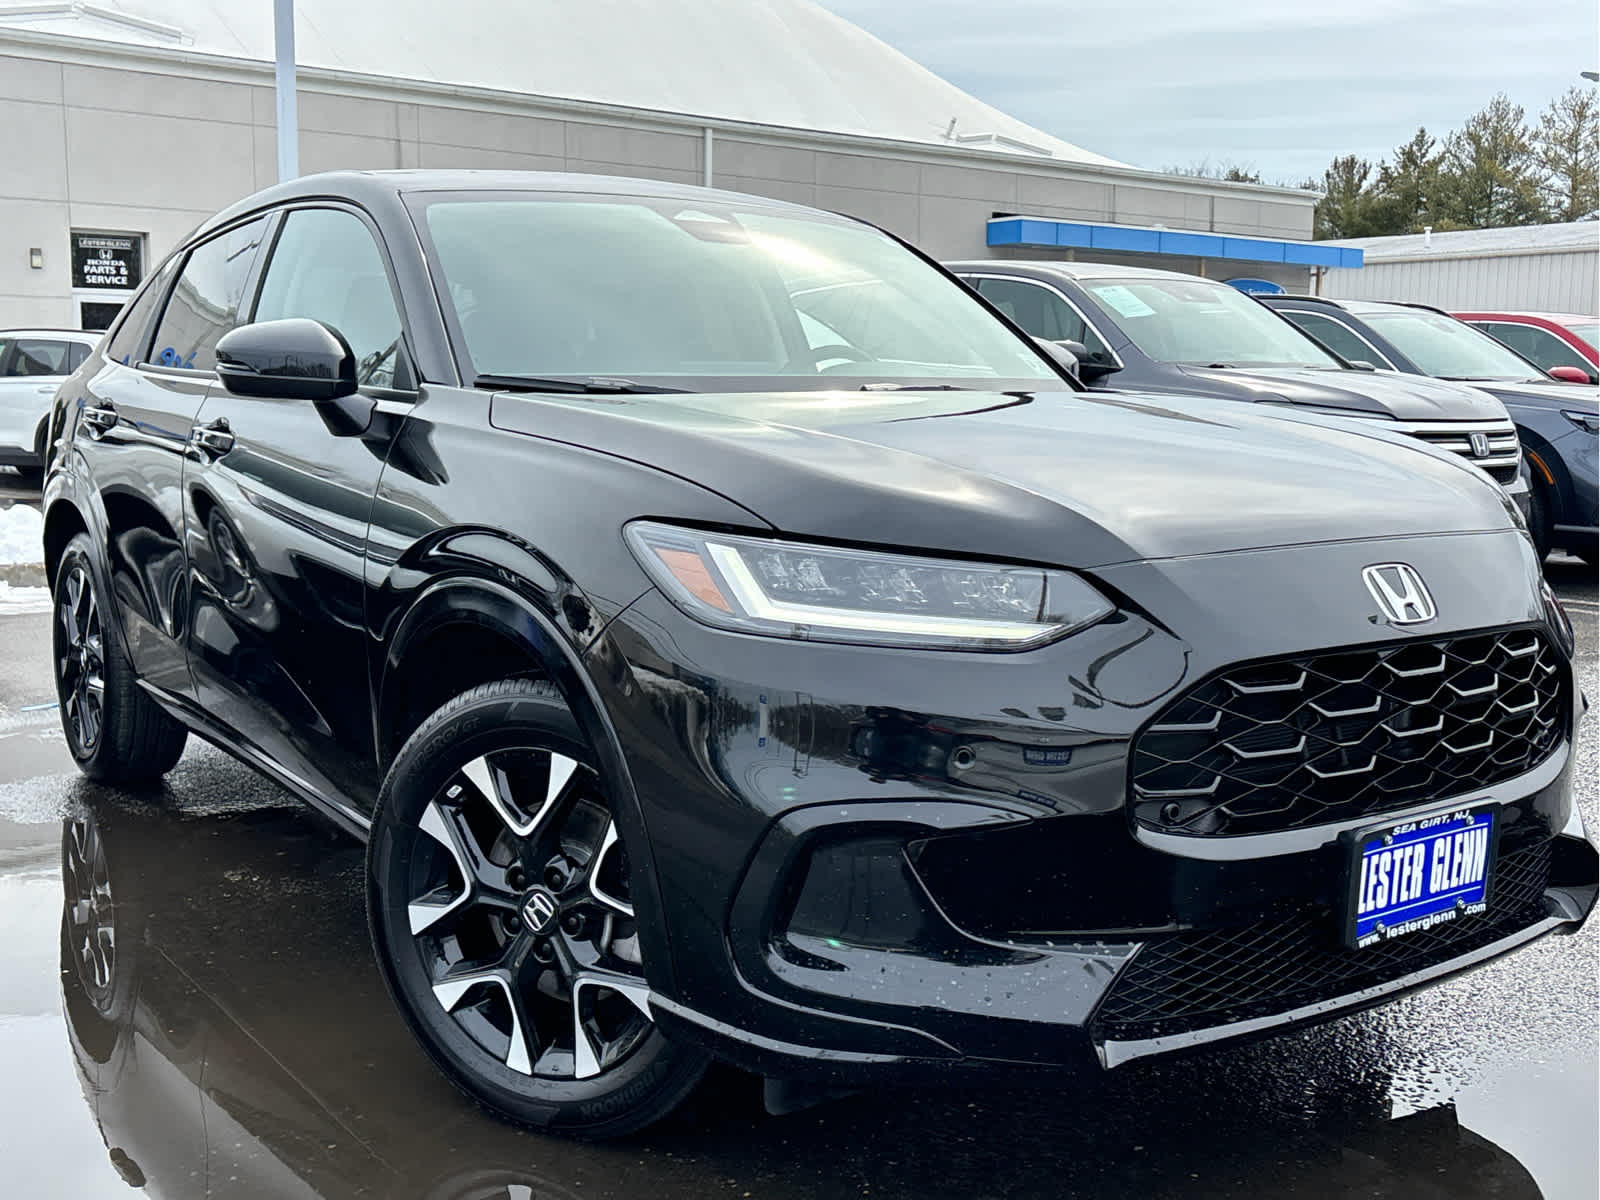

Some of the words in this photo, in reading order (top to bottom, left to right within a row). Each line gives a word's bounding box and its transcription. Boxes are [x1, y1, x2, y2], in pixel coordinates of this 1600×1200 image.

[84, 266, 117, 274] PARTS
[120, 267, 128, 275] &
[86, 275, 128, 285] SERVICE
[1391, 822, 1417, 836] SEA
[1419, 814, 1451, 829] GIRT,
[1453, 809, 1471, 821] NJ
[1357, 843, 1426, 914] LESTER
[1429, 827, 1488, 894] GLENN
[1386, 909, 1457, 939] lesterglenn
[1463, 902, 1487, 915] .com
